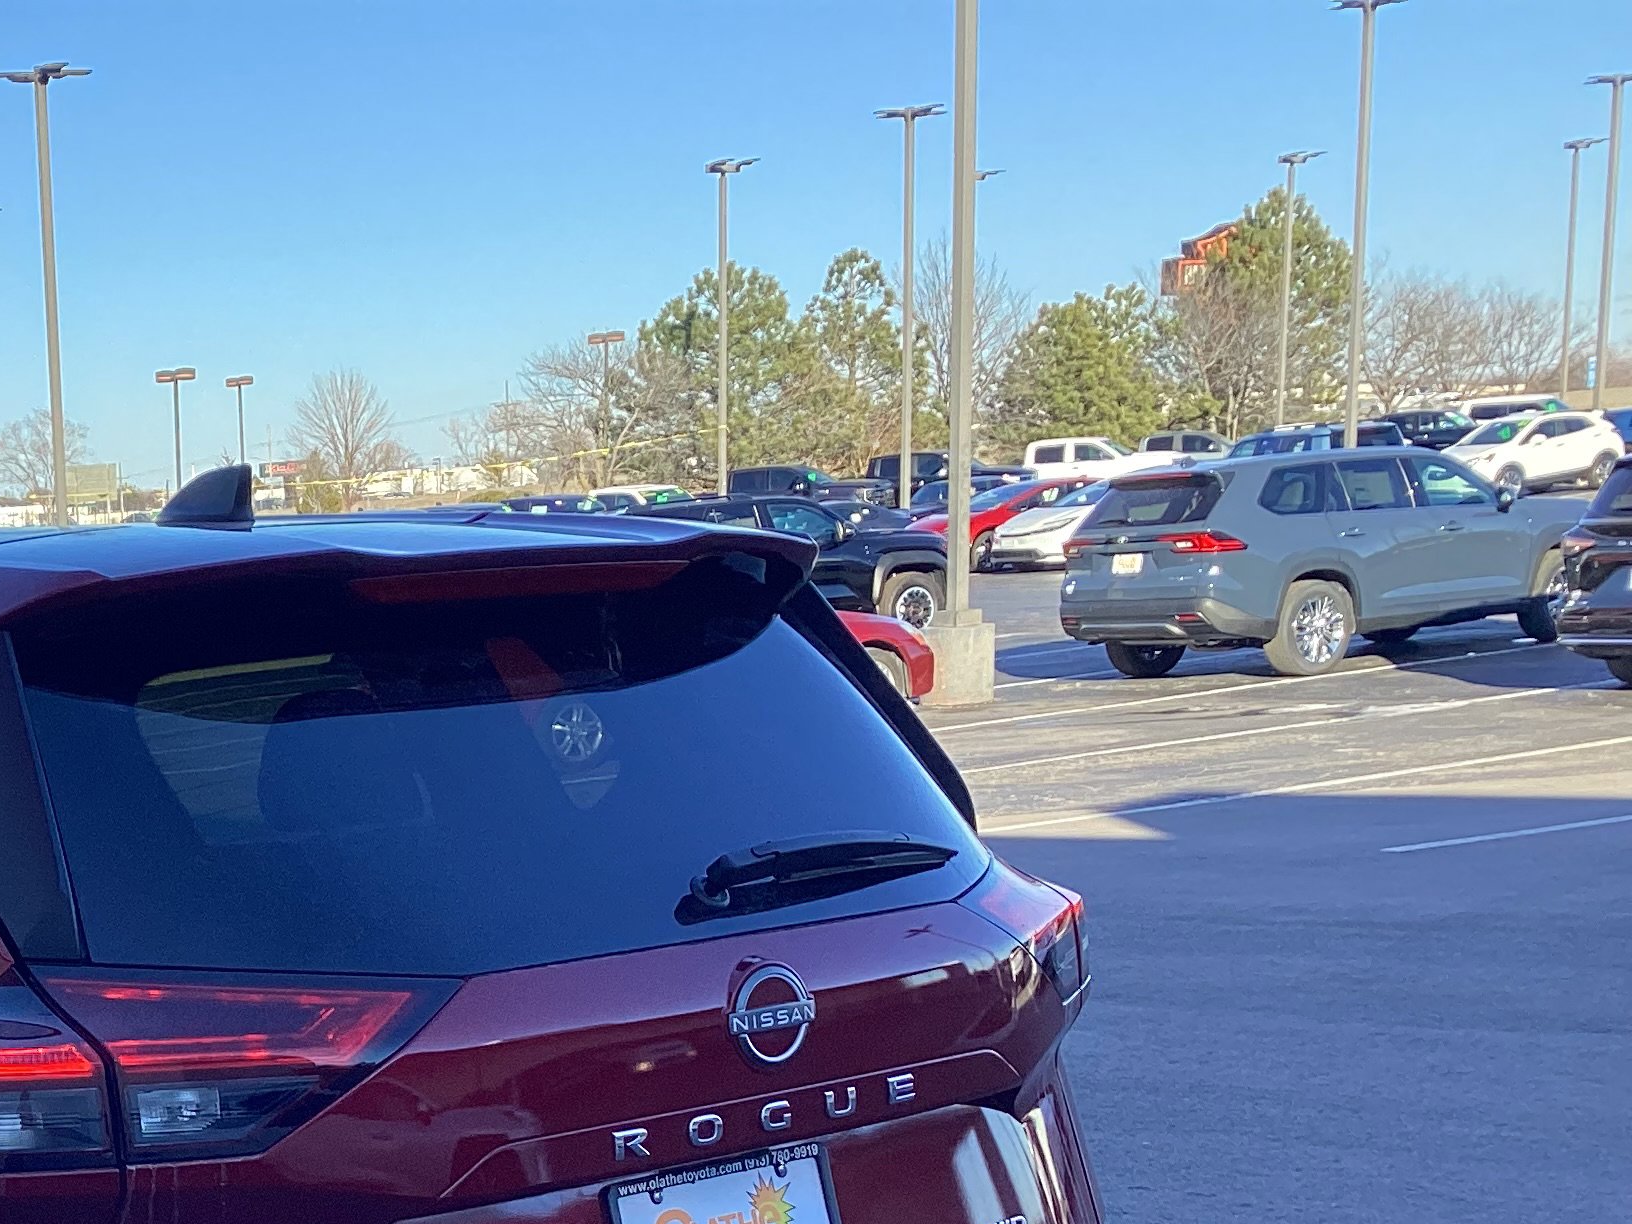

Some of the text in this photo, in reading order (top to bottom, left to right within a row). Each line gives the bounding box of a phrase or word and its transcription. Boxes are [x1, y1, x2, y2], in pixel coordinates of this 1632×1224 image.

[732, 1005, 815, 1033] NISSAN
[612, 1074, 917, 1162] ROGUE
[618, 1161, 743, 1197] www.olathetoyota.com
